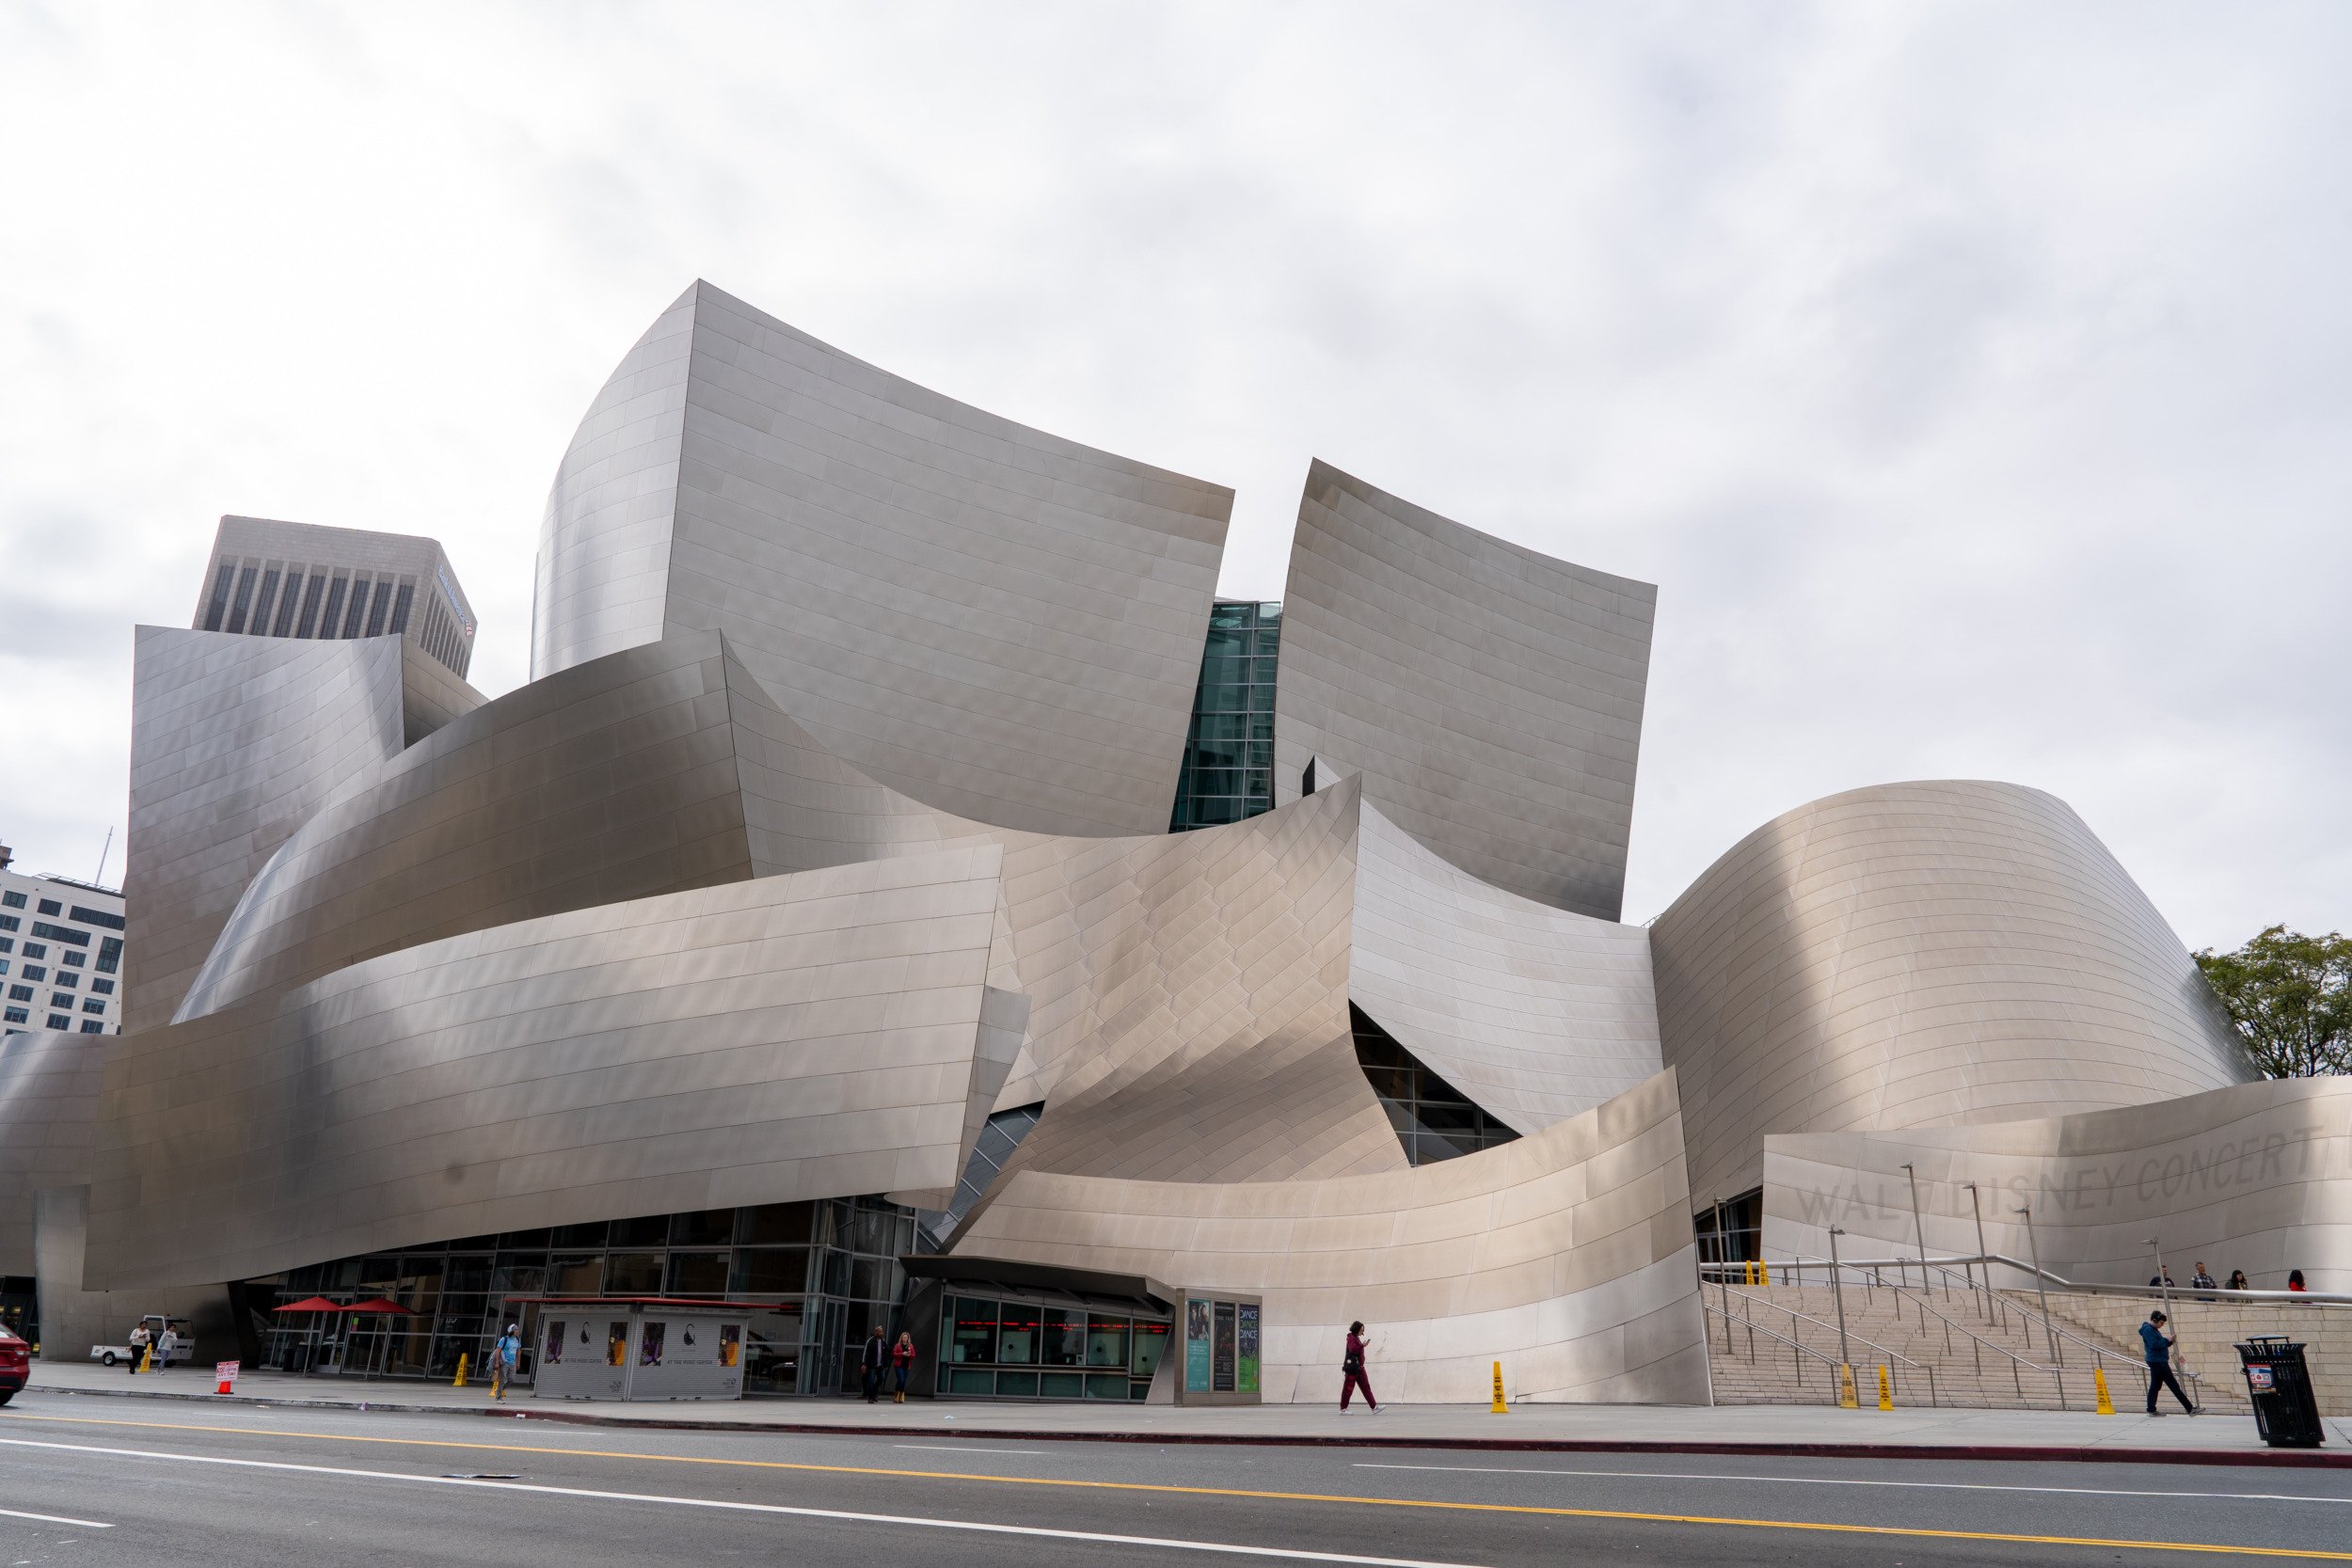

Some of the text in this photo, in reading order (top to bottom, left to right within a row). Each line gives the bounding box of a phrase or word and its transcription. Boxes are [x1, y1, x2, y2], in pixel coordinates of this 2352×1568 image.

[1795, 1181, 1931, 1223] WALT
[1951, 1164, 2125, 1217] DISNEY
[2137, 1125, 2324, 1203] CONCERT
[1240, 1310, 1258, 1320] DANCE
[1240, 1320, 1258, 1329] DANCE
[1240, 1330, 1258, 1339] DANCE
